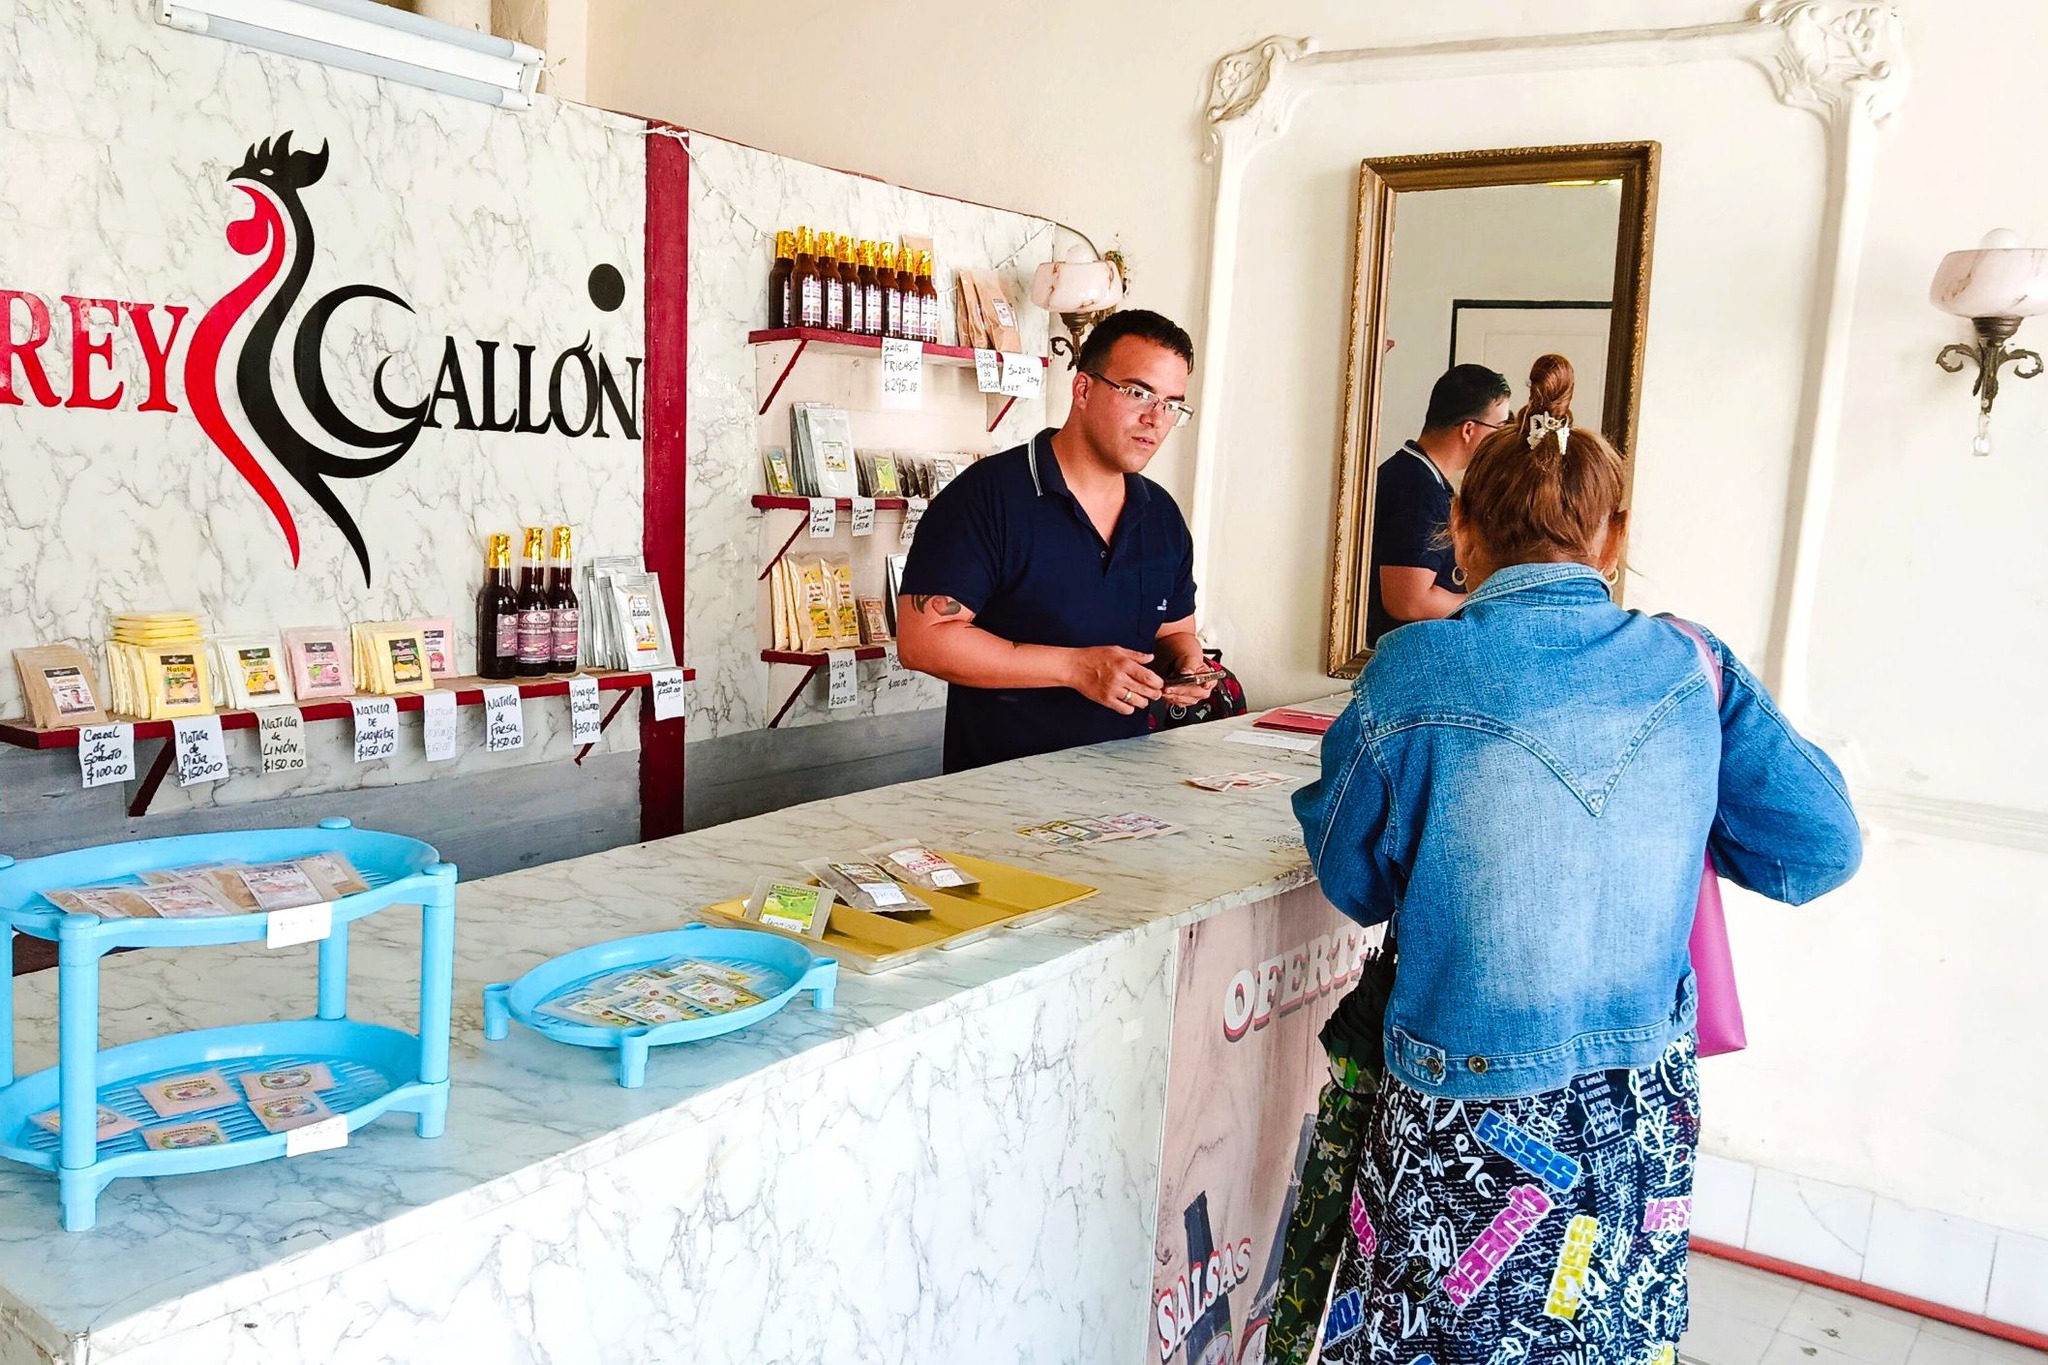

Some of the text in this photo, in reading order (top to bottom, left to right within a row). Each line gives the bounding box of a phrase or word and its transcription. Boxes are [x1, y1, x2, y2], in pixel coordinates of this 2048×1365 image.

[0, 289, 189, 413] REY
[263, 758, 304, 773] $150.00
[1157, 1238, 1252, 1363] SALSAS
